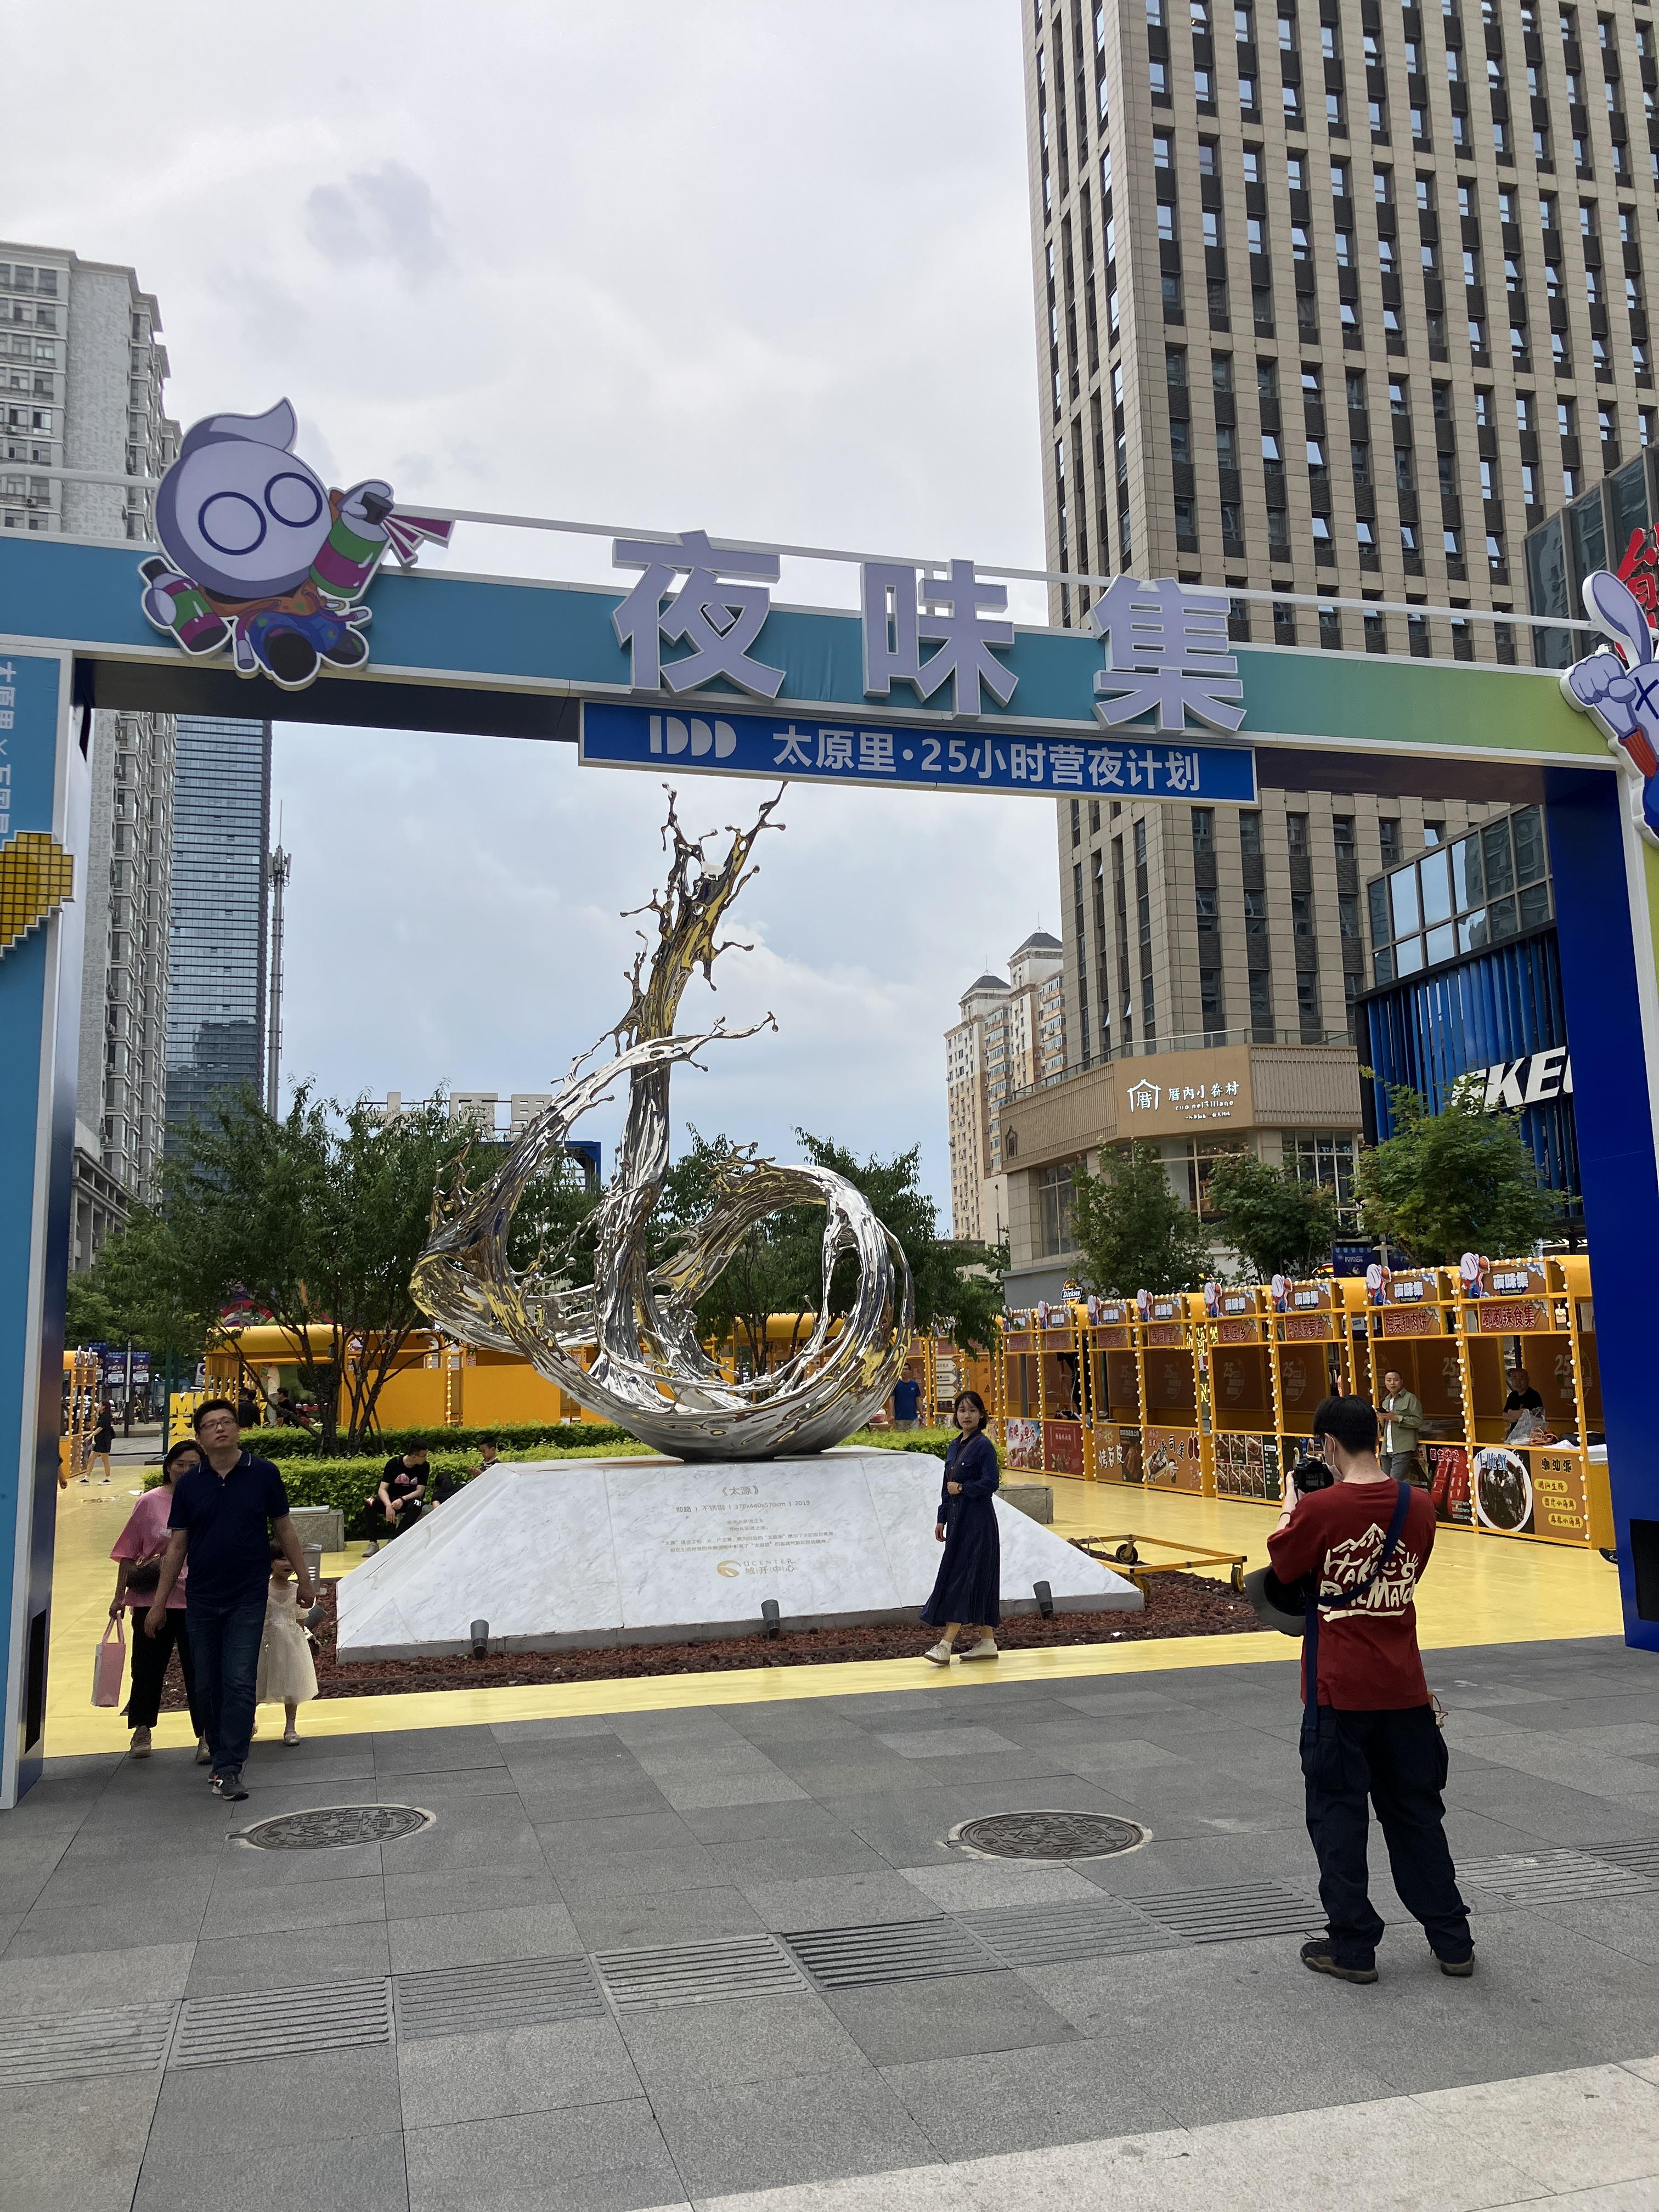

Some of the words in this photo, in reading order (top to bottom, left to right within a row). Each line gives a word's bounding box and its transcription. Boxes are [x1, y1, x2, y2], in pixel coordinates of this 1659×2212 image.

[612, 529, 1247, 735] 夜味集
[772, 725, 1200, 792] 太原里·25小时营夜计划
[1493, 1272, 1529, 1289] 夜味集
